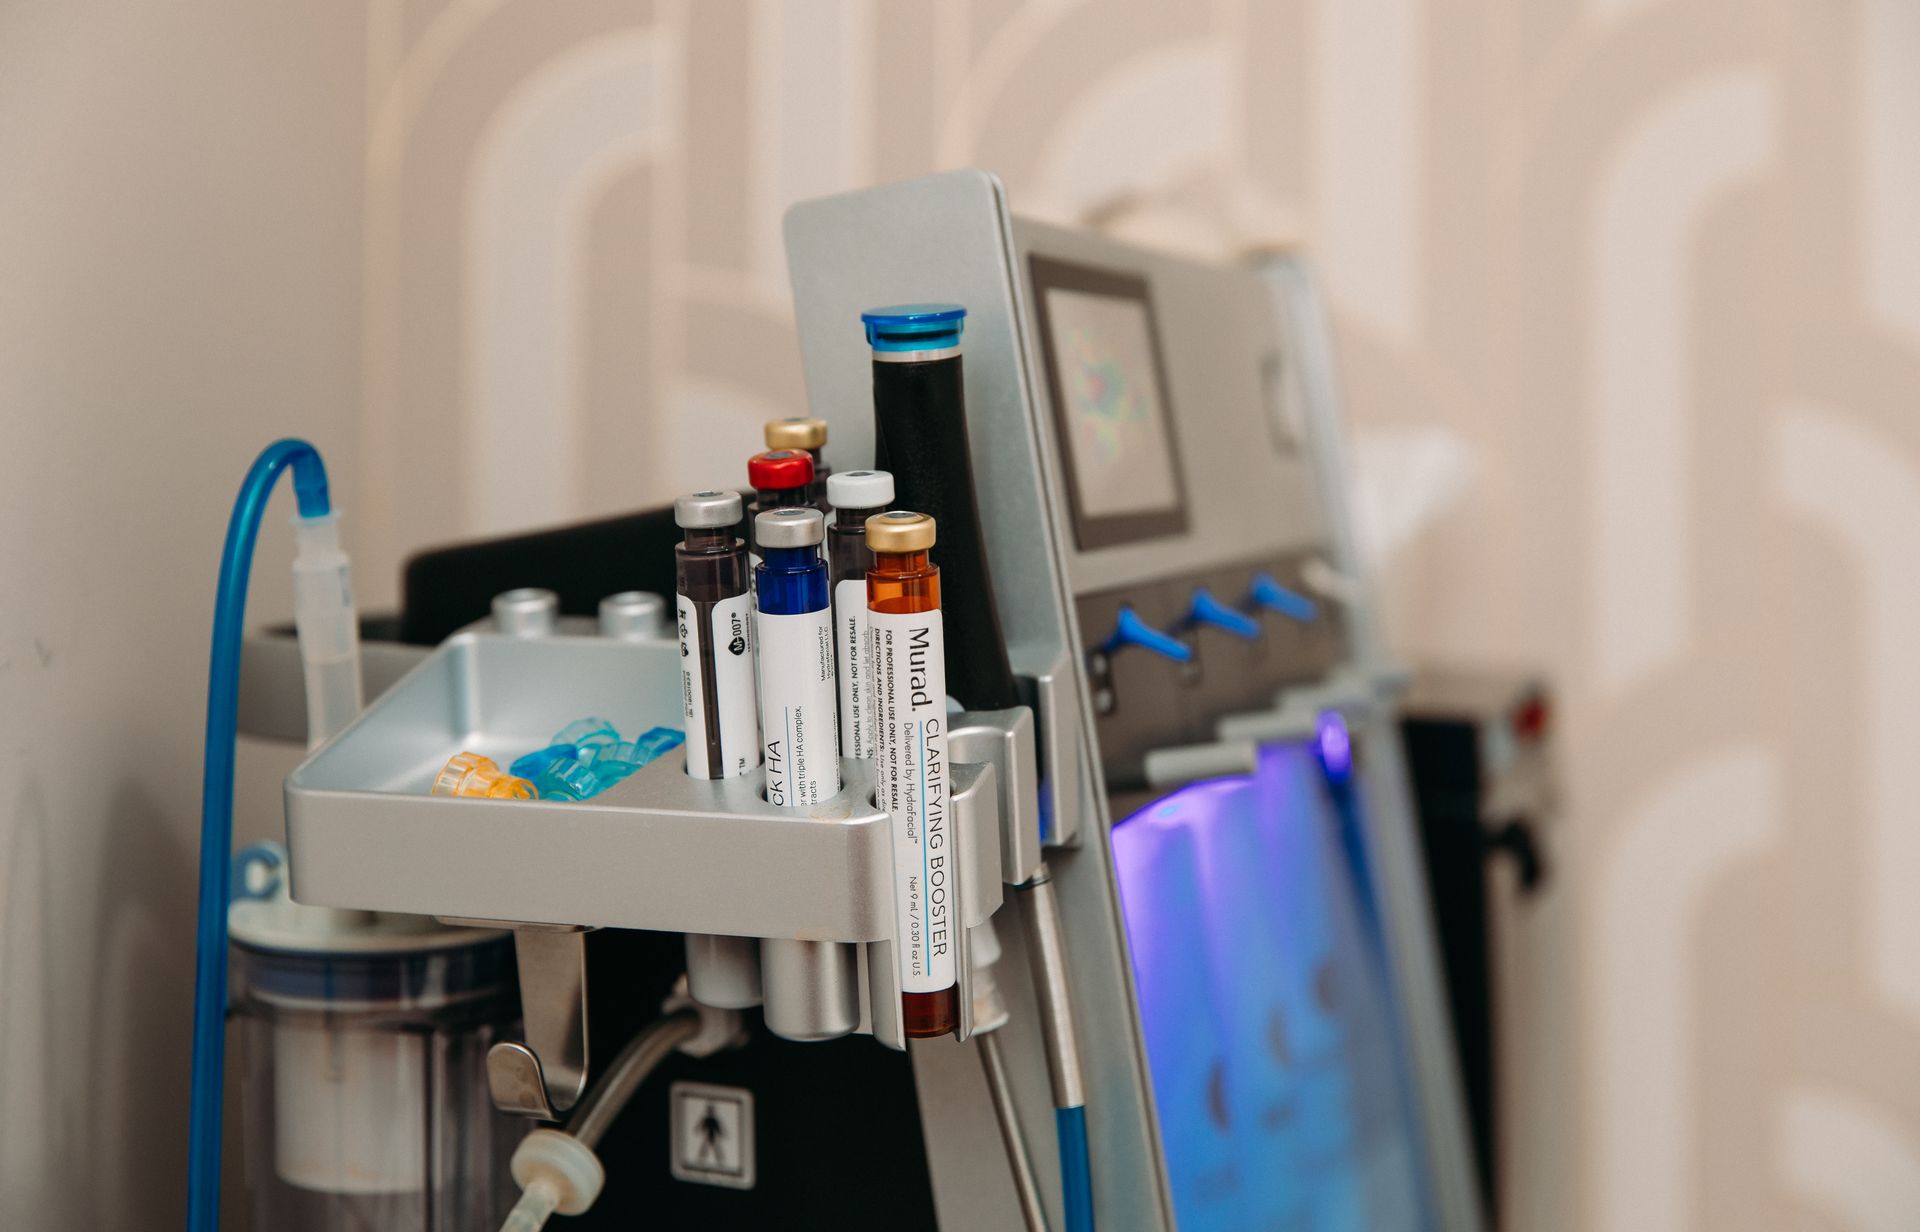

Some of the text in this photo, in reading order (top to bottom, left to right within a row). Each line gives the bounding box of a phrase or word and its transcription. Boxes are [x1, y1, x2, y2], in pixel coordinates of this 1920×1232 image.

[848, 615, 857, 644] RESALE.
[885, 629, 893, 645] FOR
[874, 628, 882, 675] DIRECTIONS
[862, 666, 871, 680] and
[886, 647, 895, 704] PROFESSIONAL
[909, 627, 933, 712] Murad.
[888, 706, 896, 720] USE
[793, 705, 804, 743] complex,
[877, 697, 885, 752] INGREDIENTS:
[888, 723, 896, 745] ONLY,
[796, 744, 804, 757] HA
[904, 722, 915, 766] Delivered
[768, 741, 782, 774] HA
[889, 747, 897, 765] NOT
[796, 758, 806, 779] triple
[890, 766, 898, 781] FOR
[904, 769, 915, 781] by
[799, 780, 807, 798] with
[926, 719, 947, 957] CLARIFYING BOOSTER
[909, 876, 918, 892] Net
[910, 922, 920, 942] 0.30
[911, 950, 917, 960] oz
